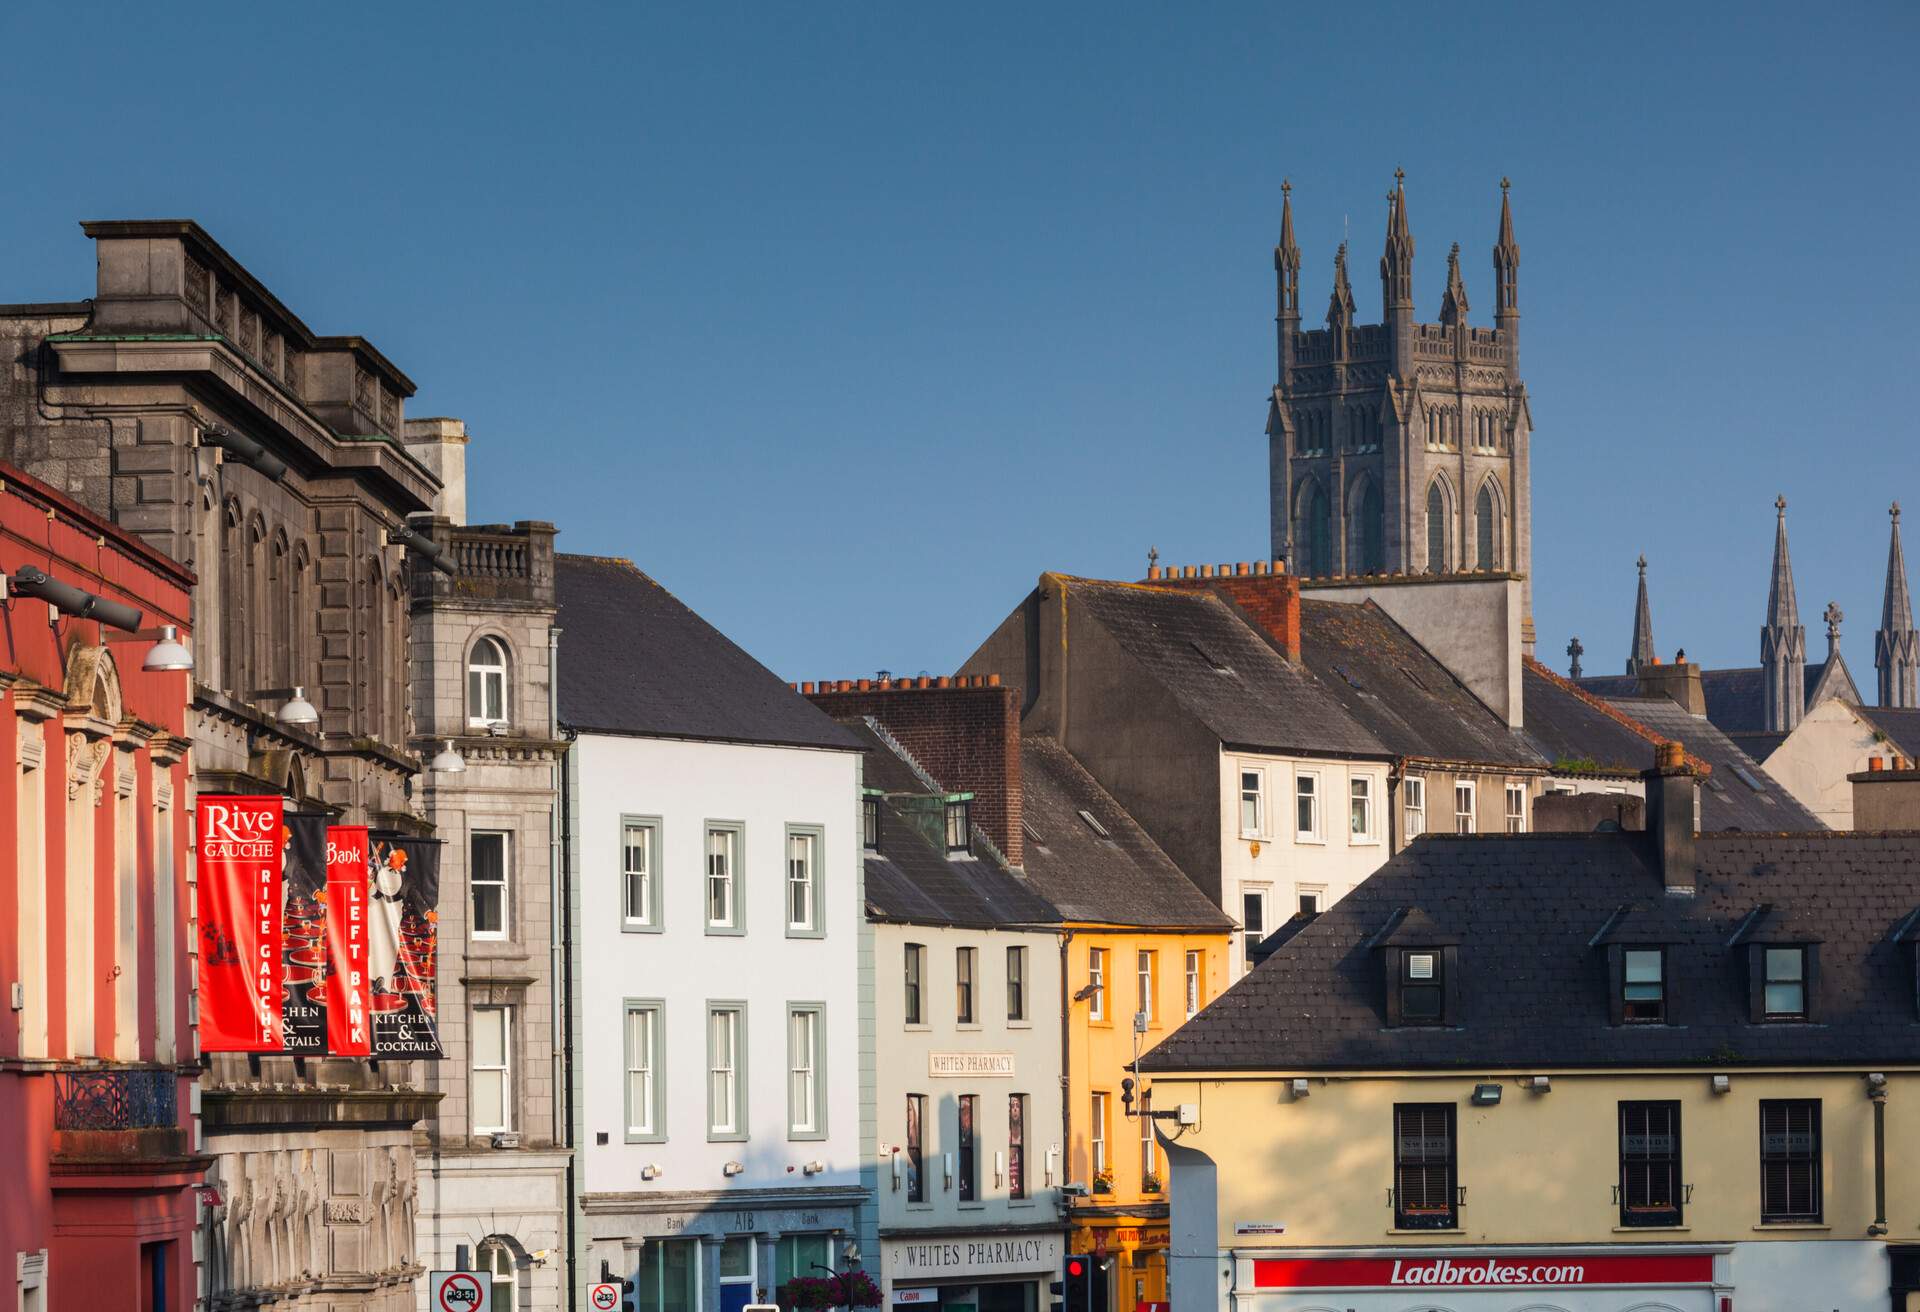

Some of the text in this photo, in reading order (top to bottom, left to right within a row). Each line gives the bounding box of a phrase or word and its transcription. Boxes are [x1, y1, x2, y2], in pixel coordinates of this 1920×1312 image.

[204, 805, 274, 843] Rive
[204, 843, 274, 858] GAUCHE
[326, 842, 361, 866] Bank
[259, 869, 272, 1044] RIVE GAUCHE
[349, 886, 363, 1044] LEFT BANK
[398, 1024, 415, 1040] &
[375, 1041, 437, 1052] COCKTAILS
[933, 1056, 1012, 1071] WHITES PHARMACY
[667, 1217, 686, 1230] Bank
[735, 1212, 755, 1231] AIB
[893, 1240, 1054, 1267] 5 WHITES PHARMACY 5
[1390, 1259, 1584, 1285] Ladbrokes.com
[899, 1291, 920, 1302] Canon
